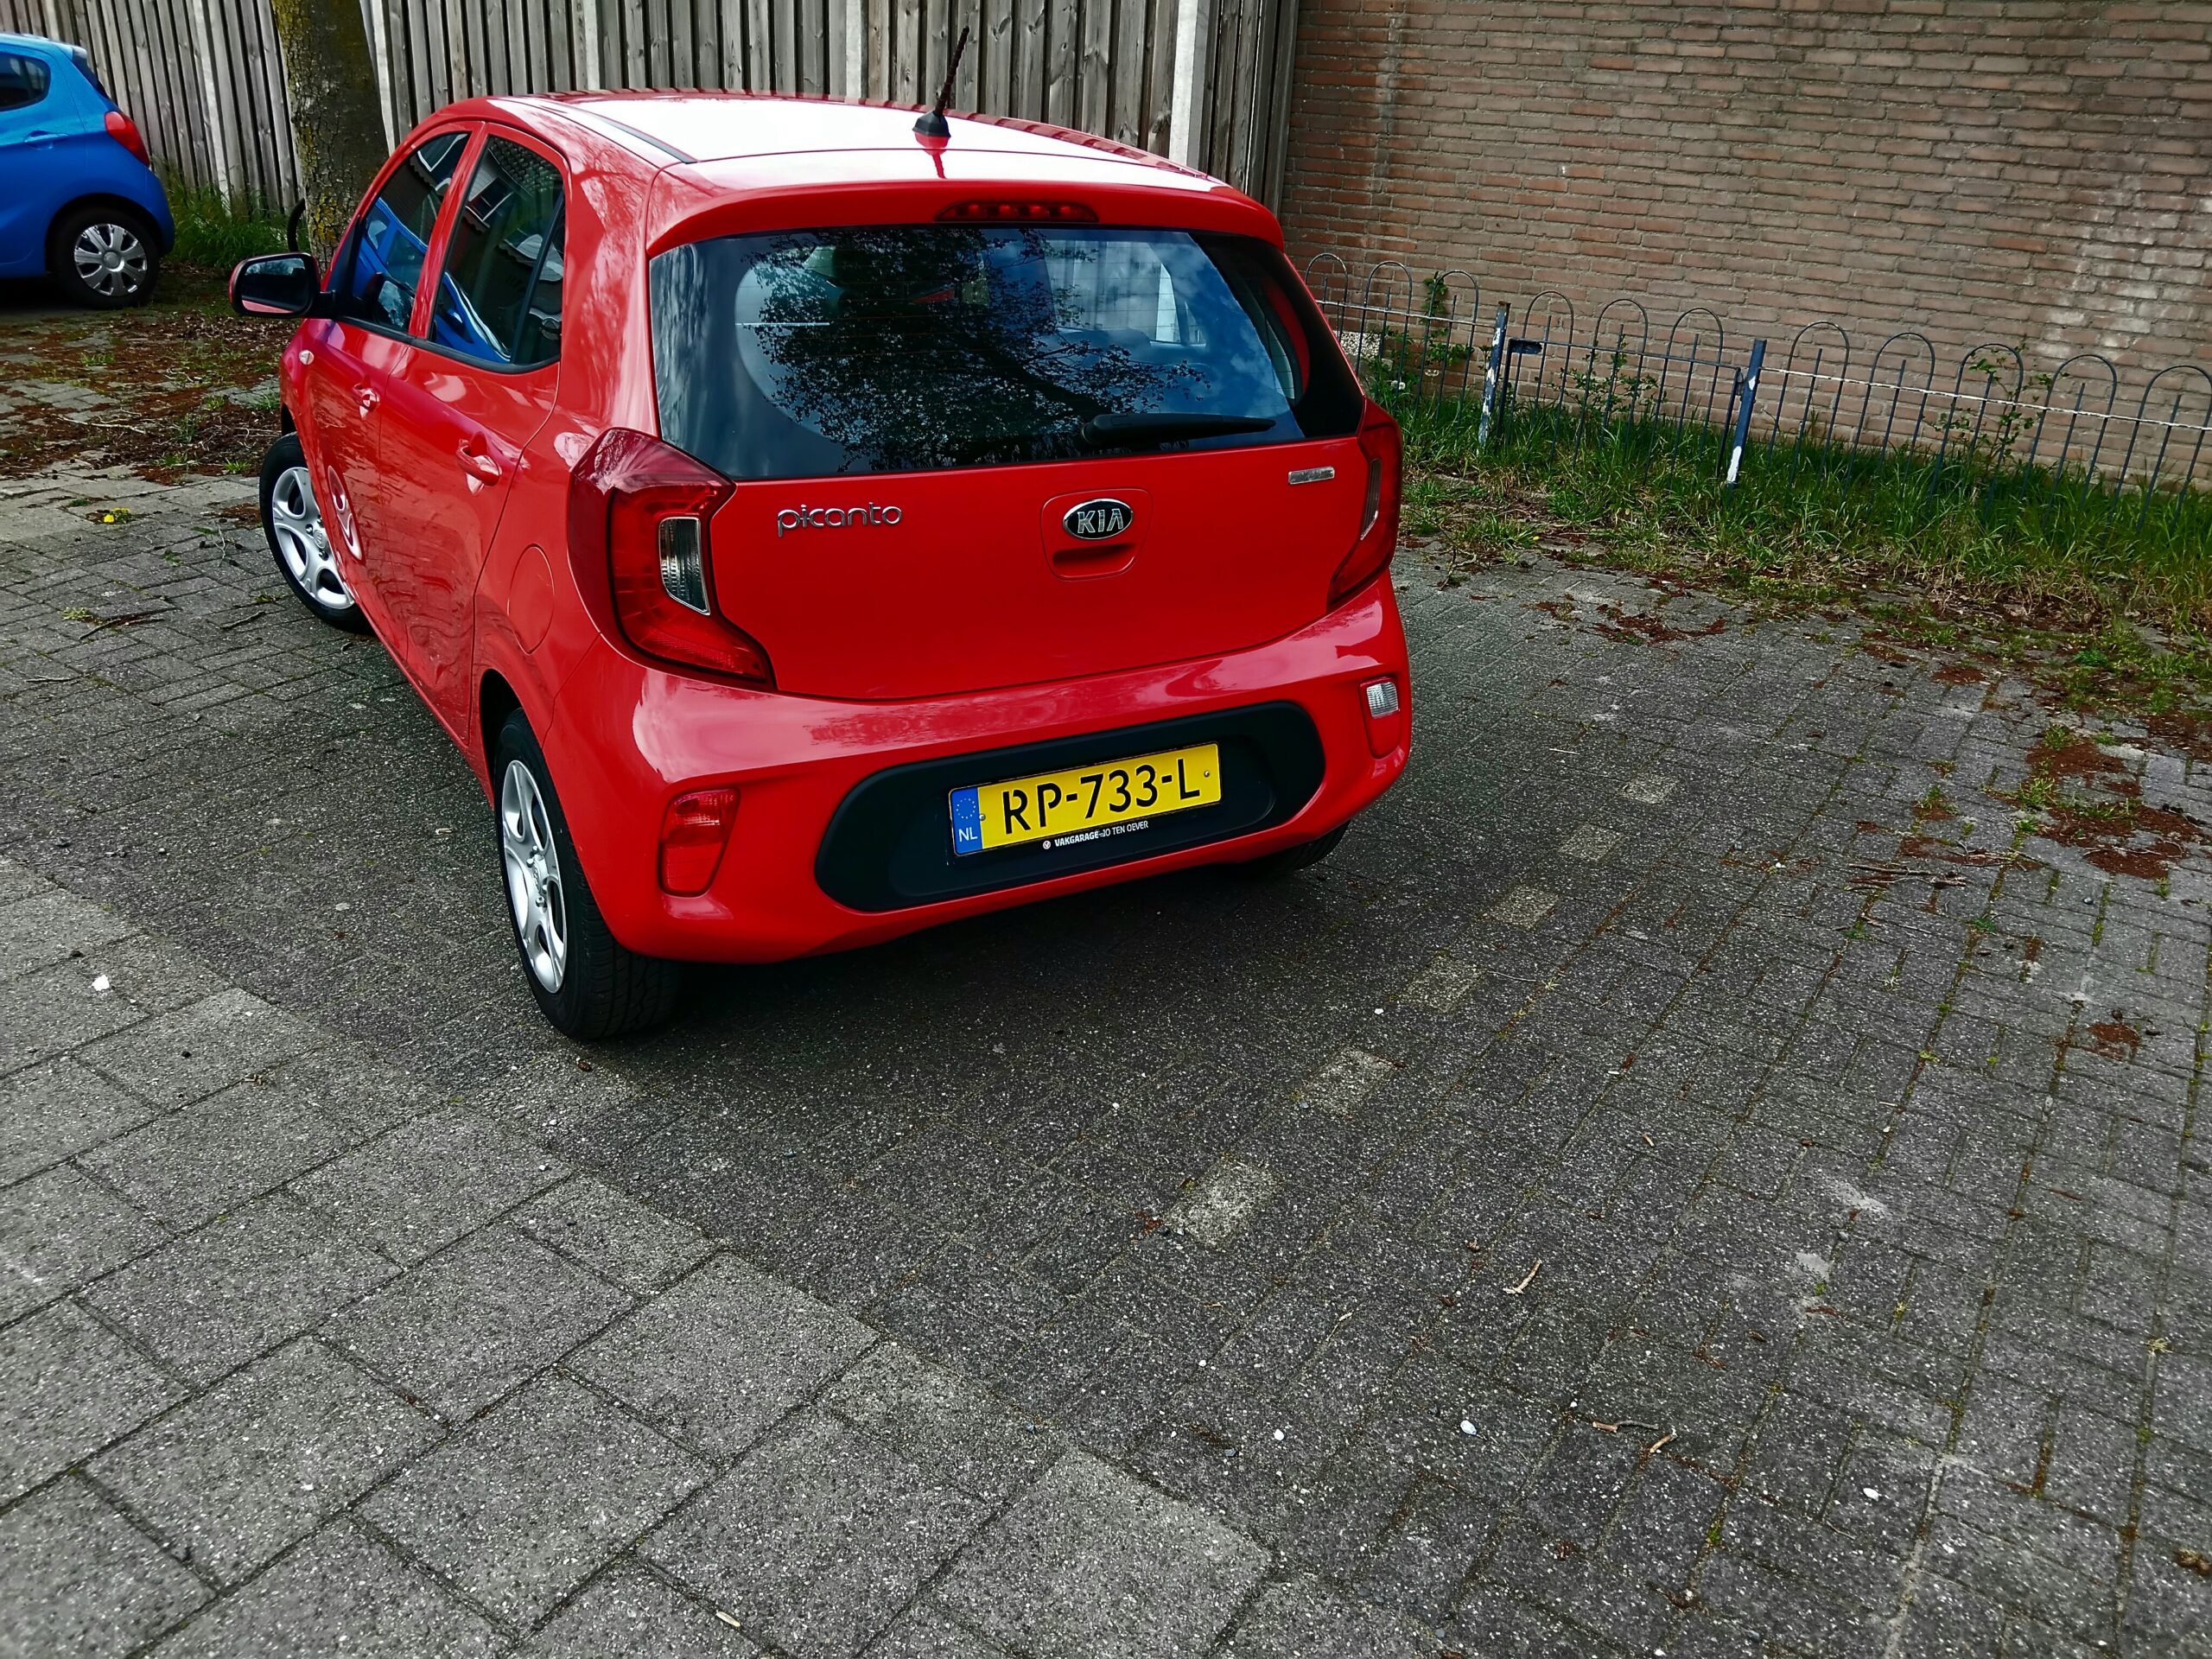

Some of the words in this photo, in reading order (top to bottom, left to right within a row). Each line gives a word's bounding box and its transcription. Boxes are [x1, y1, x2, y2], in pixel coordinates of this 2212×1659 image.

[778, 502, 902, 537] picanto
[1077, 508, 1124, 534] KIA
[1002, 758, 1200, 835] RP-733-L
[958, 826, 978, 842] NL
[1112, 825, 1126, 836] TEN
[1126, 820, 1149, 832] OEVER
